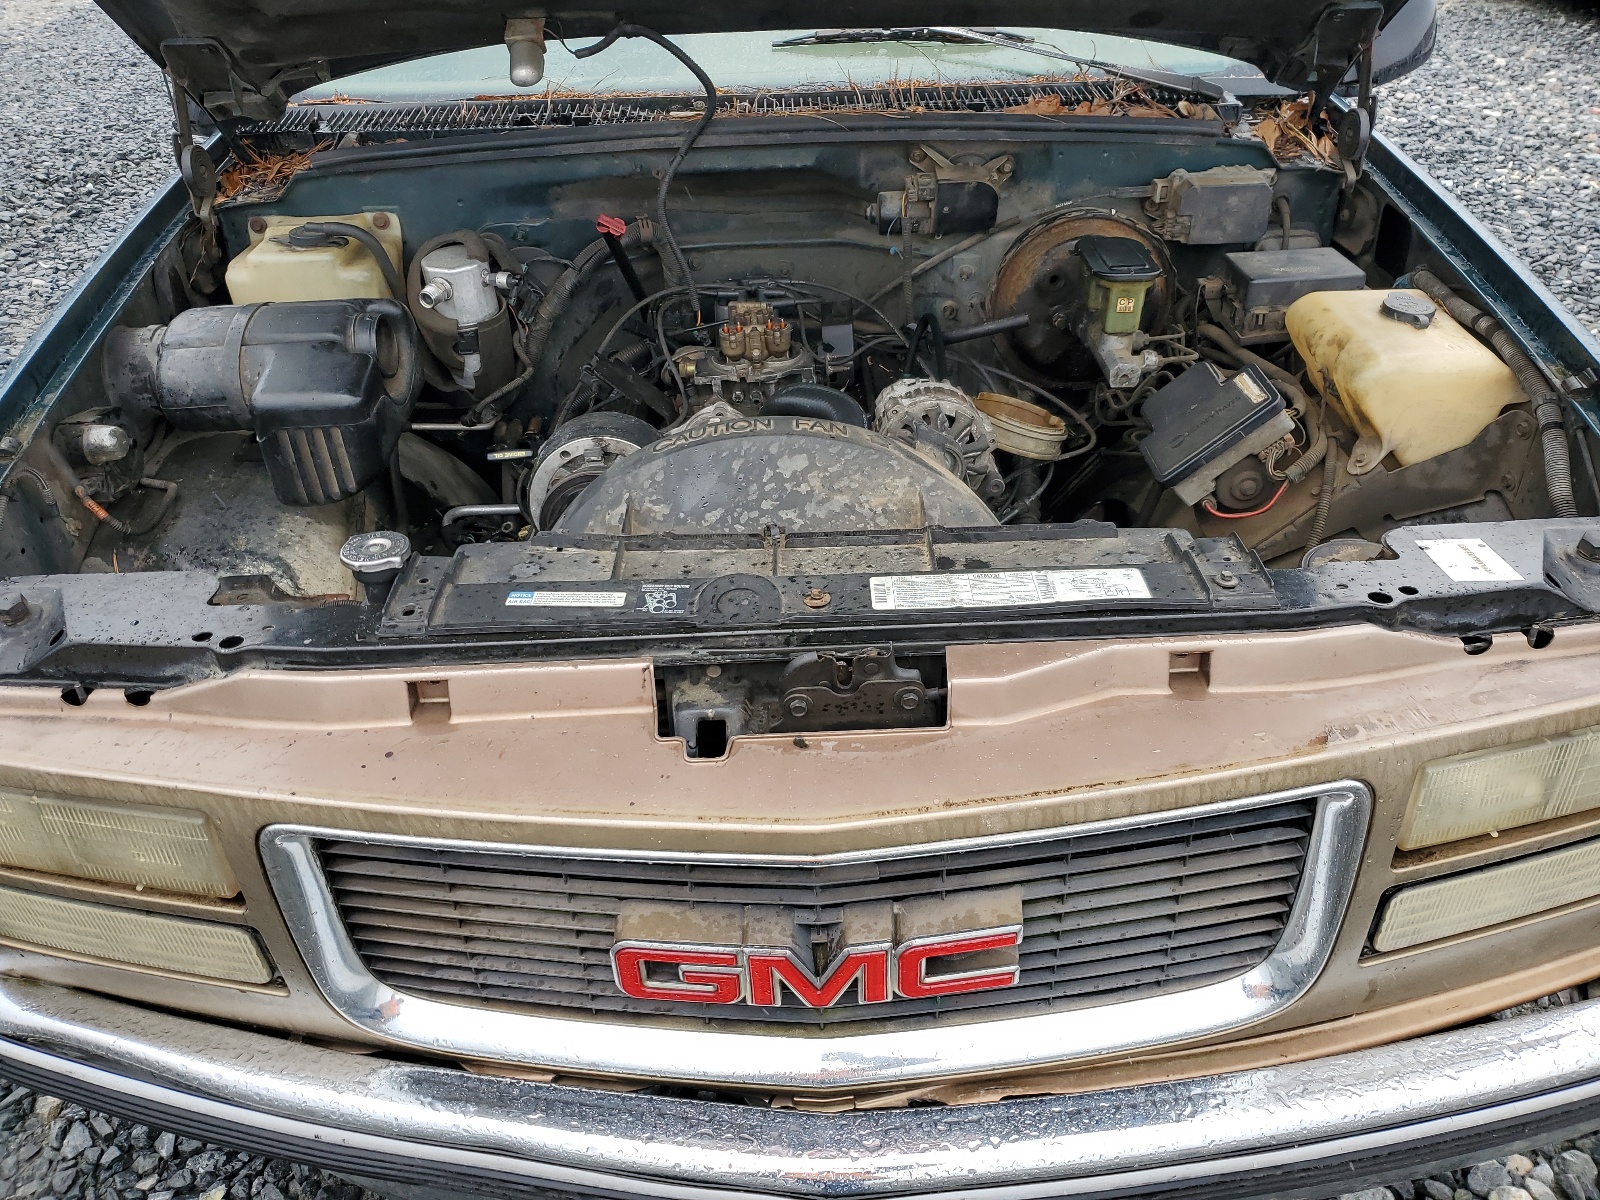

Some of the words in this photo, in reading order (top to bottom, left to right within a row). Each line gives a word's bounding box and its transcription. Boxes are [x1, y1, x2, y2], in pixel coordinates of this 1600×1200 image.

[652, 418, 774, 453] CAUTION
[792, 418, 850, 438] FAN
[609, 925, 1023, 1008] GMC
